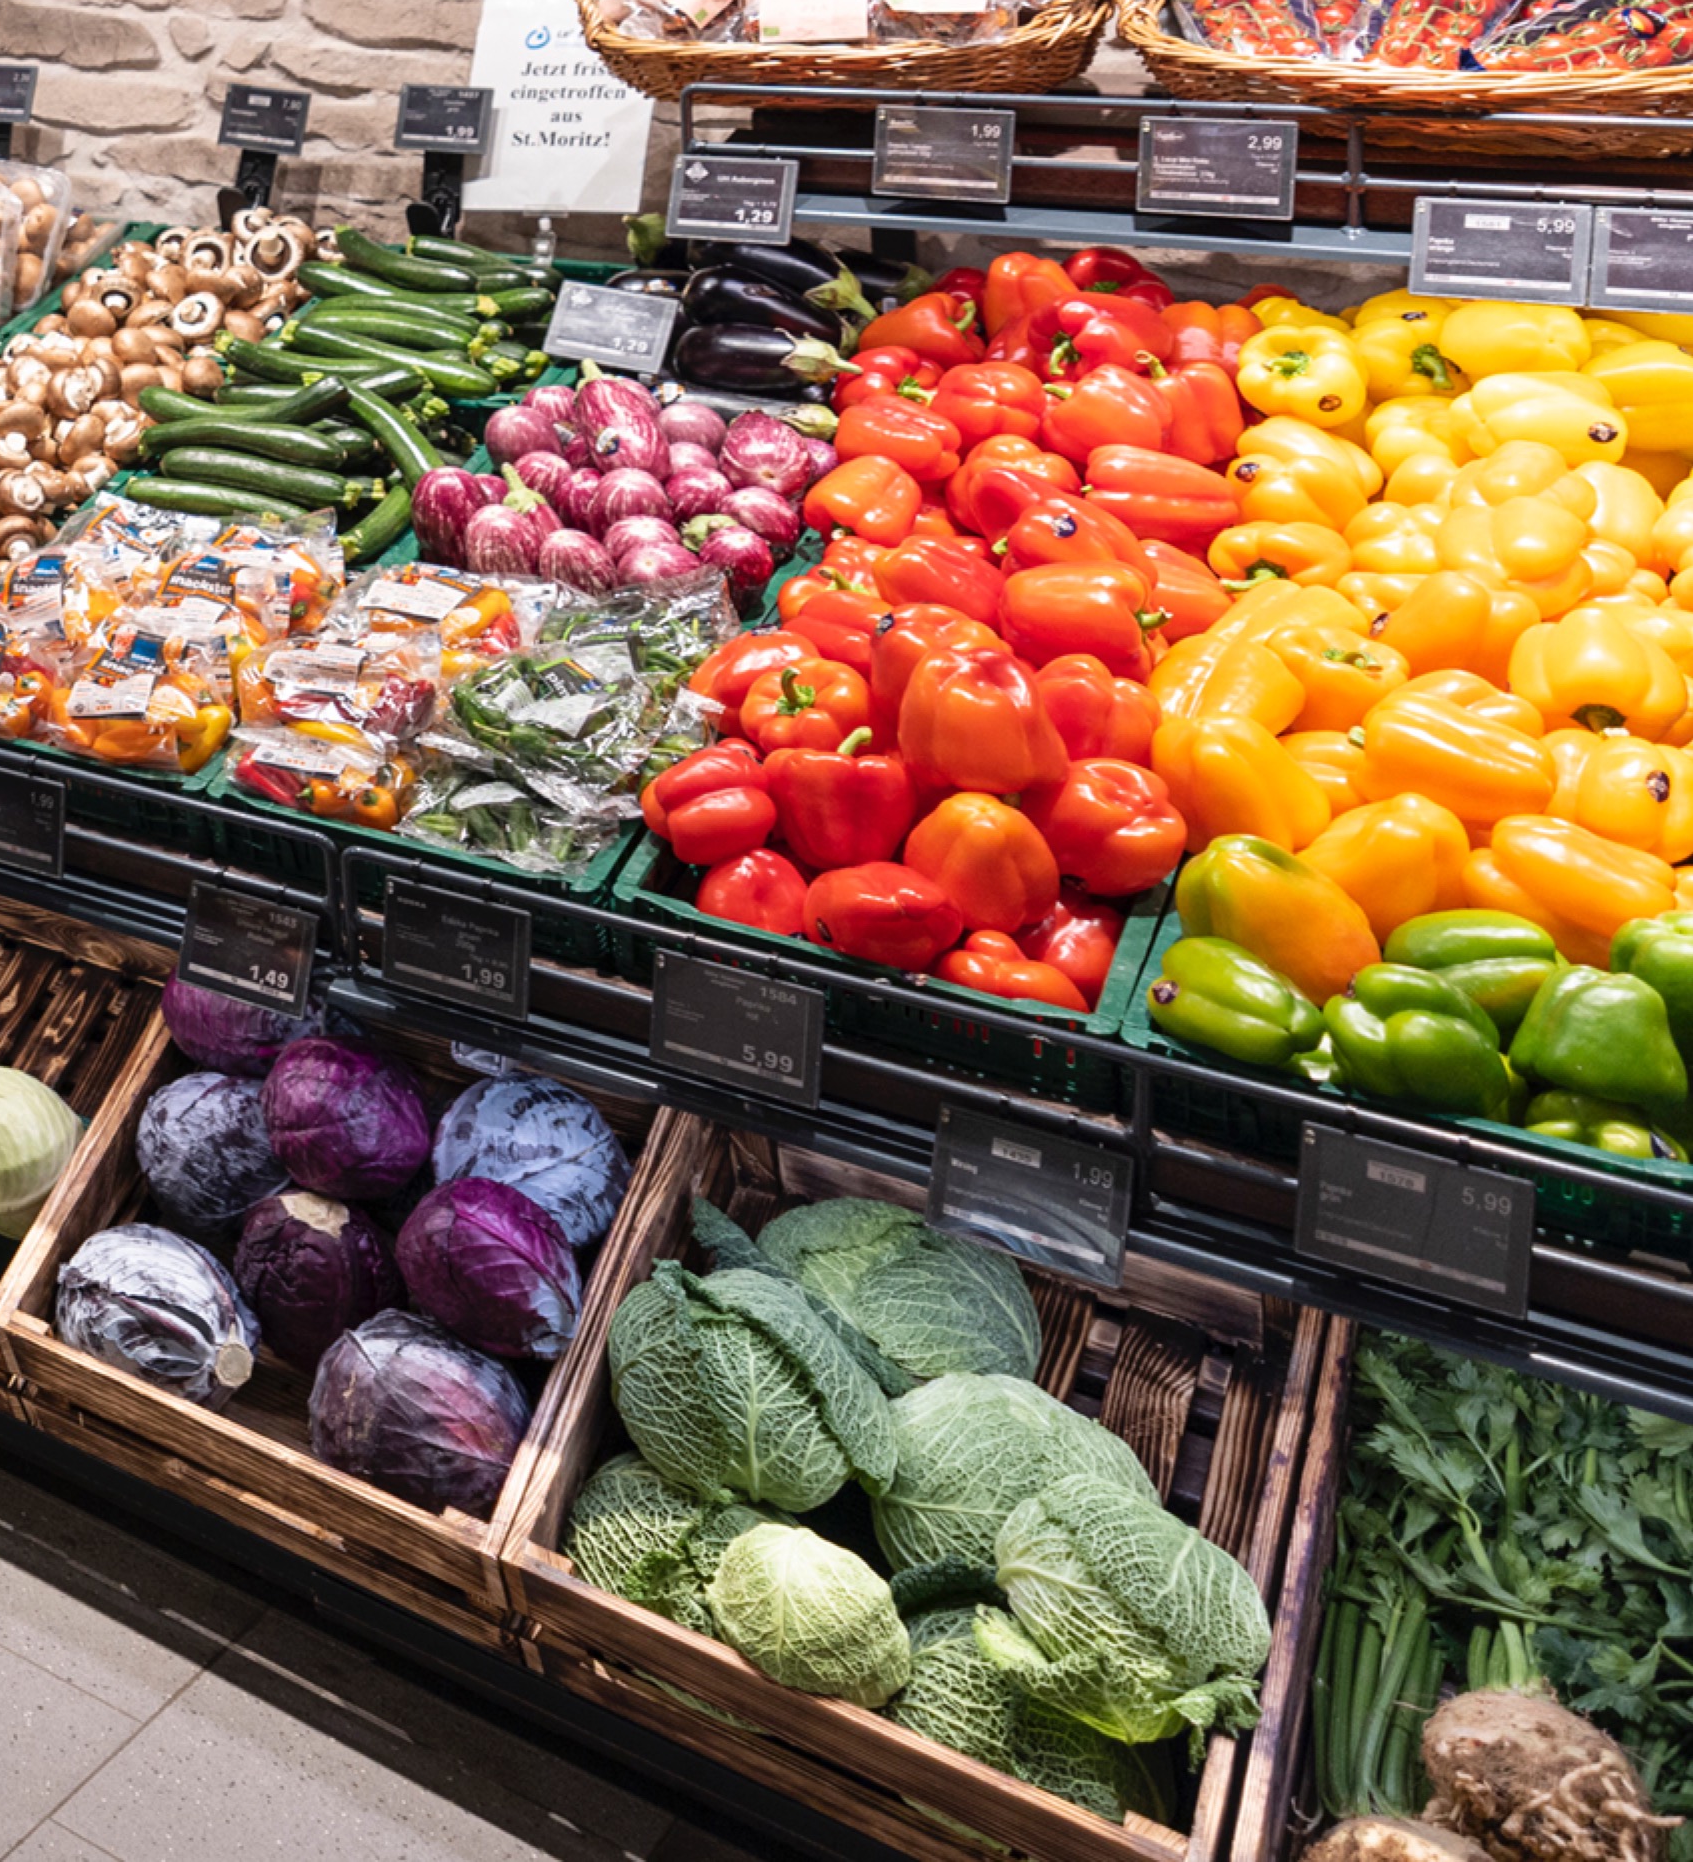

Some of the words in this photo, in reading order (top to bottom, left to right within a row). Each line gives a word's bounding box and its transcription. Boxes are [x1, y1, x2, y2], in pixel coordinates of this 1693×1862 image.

[521, 61, 568, 78] Jetzt
[510, 84, 627, 102] eingetroffen
[550, 110, 583, 124] aus
[511, 130, 611, 148] St.Moritz!
[971, 123, 1002, 139] 1,99
[1247, 135, 1283, 151] 2,99
[734, 207, 775, 225] 1,29
[1536, 217, 1576, 235] 5,99
[248, 963, 289, 990] 1,49
[461, 962, 506, 990] 1,99
[760, 987, 798, 1006] 1584
[742, 1043, 794, 1074] 5,99
[1072, 1161, 1114, 1189] 1,99
[1461, 1184, 1513, 1219] 5,99
